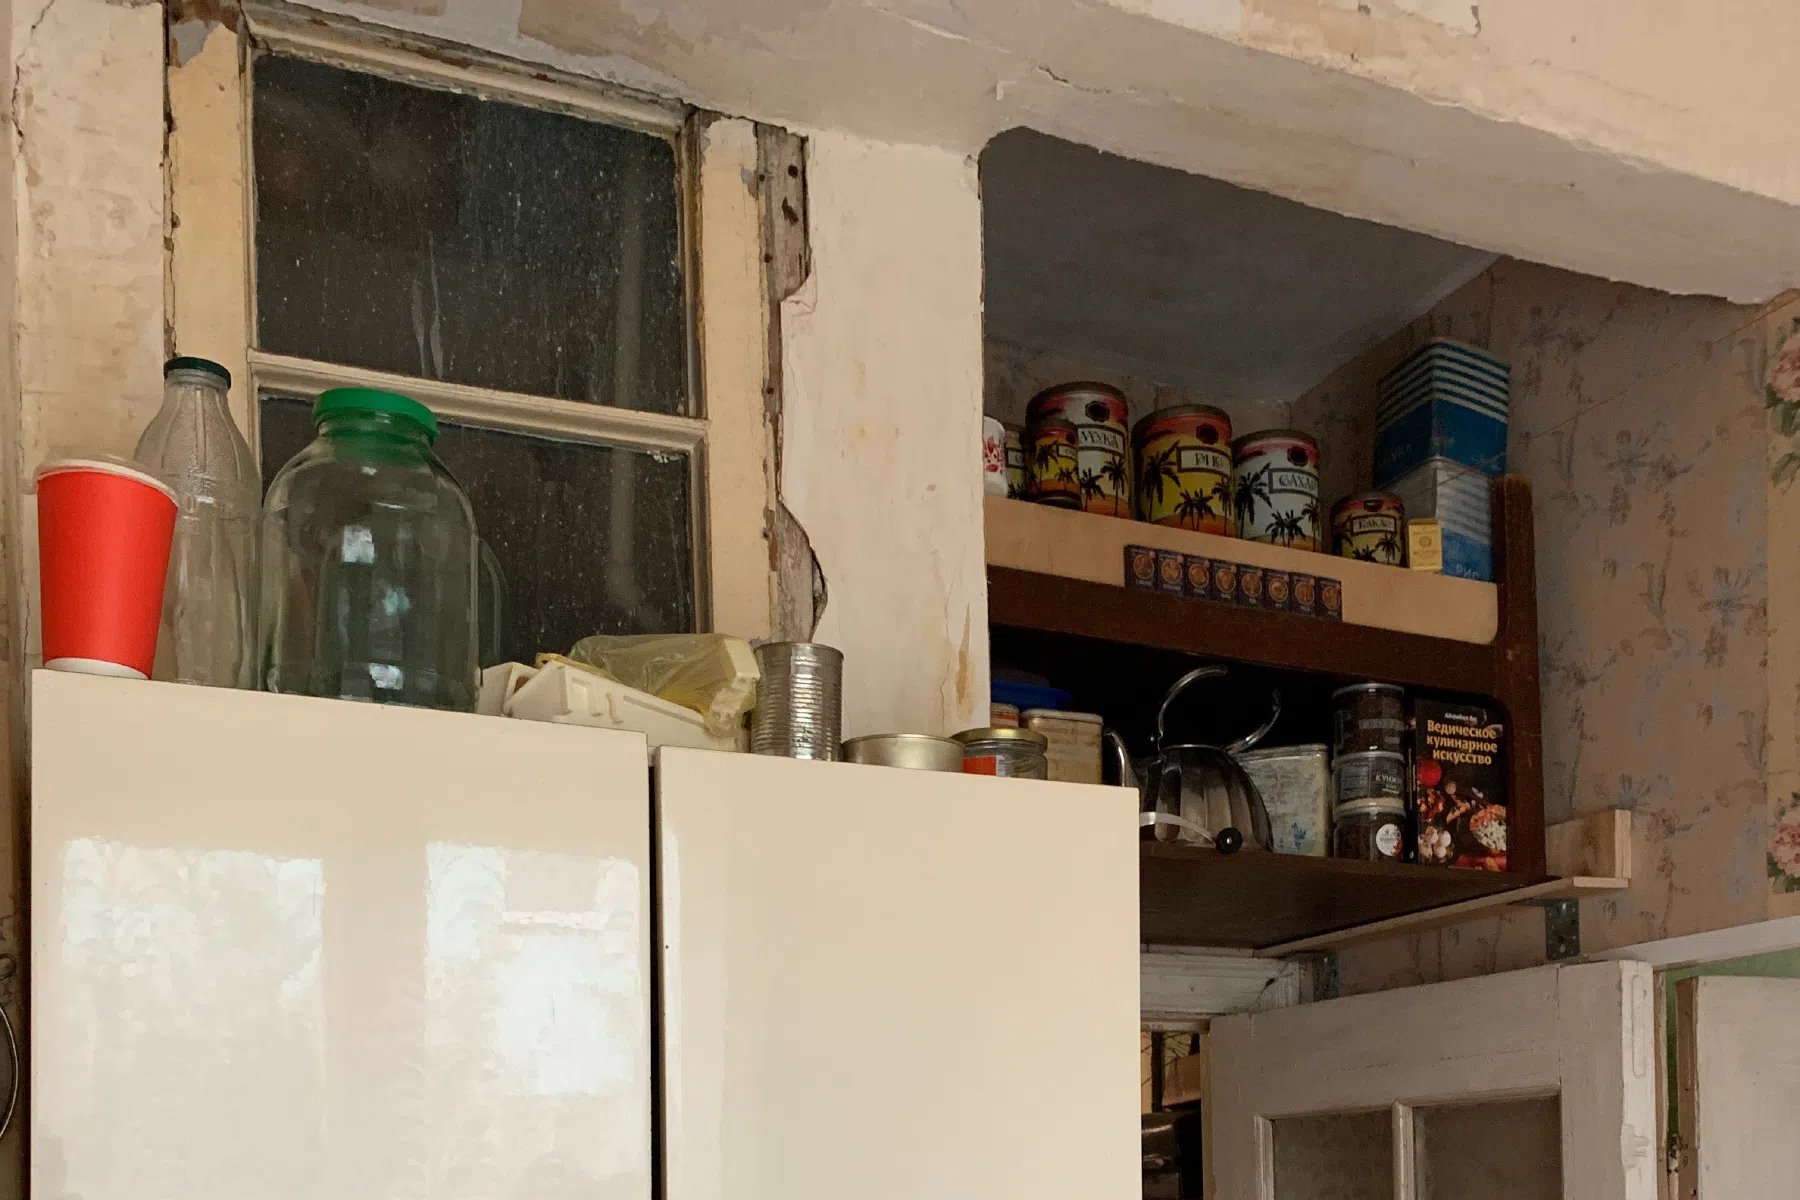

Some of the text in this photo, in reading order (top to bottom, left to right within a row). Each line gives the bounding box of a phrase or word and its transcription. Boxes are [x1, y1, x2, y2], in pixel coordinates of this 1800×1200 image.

[1427, 719, 1497, 740] Ведическое
[1426, 735, 1498, 753] кулинарное
[1432, 749, 1492, 765] искусство
